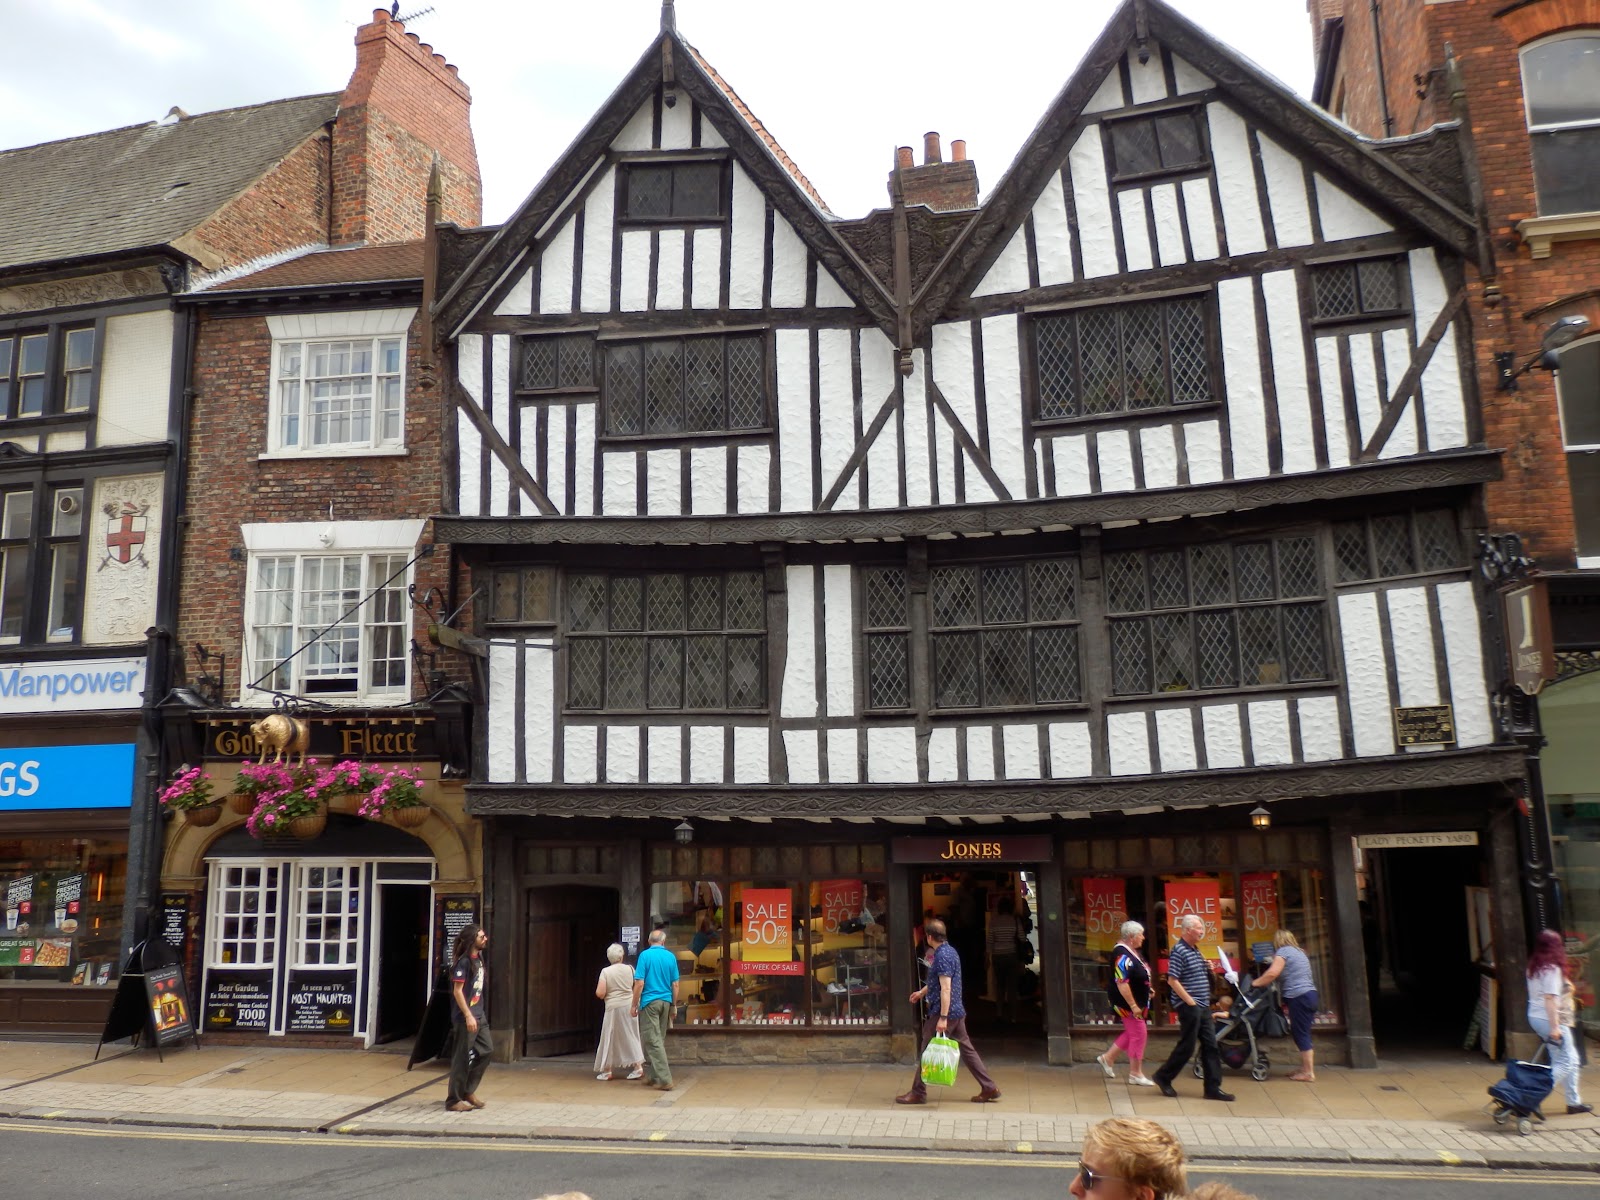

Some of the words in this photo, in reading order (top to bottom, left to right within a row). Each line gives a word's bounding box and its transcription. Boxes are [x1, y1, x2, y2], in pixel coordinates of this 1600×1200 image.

[0, 669, 138, 702] Manpower
[340, 728, 417, 756] Fleece
[1365, 837, 1389, 846] LADY
[1446, 834, 1471, 843] YARD
[941, 840, 1001, 859] JONES
[825, 891, 859, 908] SALE
[1087, 893, 1122, 909] SALE
[1244, 888, 1273, 905] SALE
[746, 903, 787, 919] SALE
[1170, 898, 1216, 915] SALE
[745, 920, 788, 945] 50%
[291, 993, 313, 1004] MOST
[316, 993, 352, 1004] HAUNTED
[239, 1009, 266, 1020] FOOD
